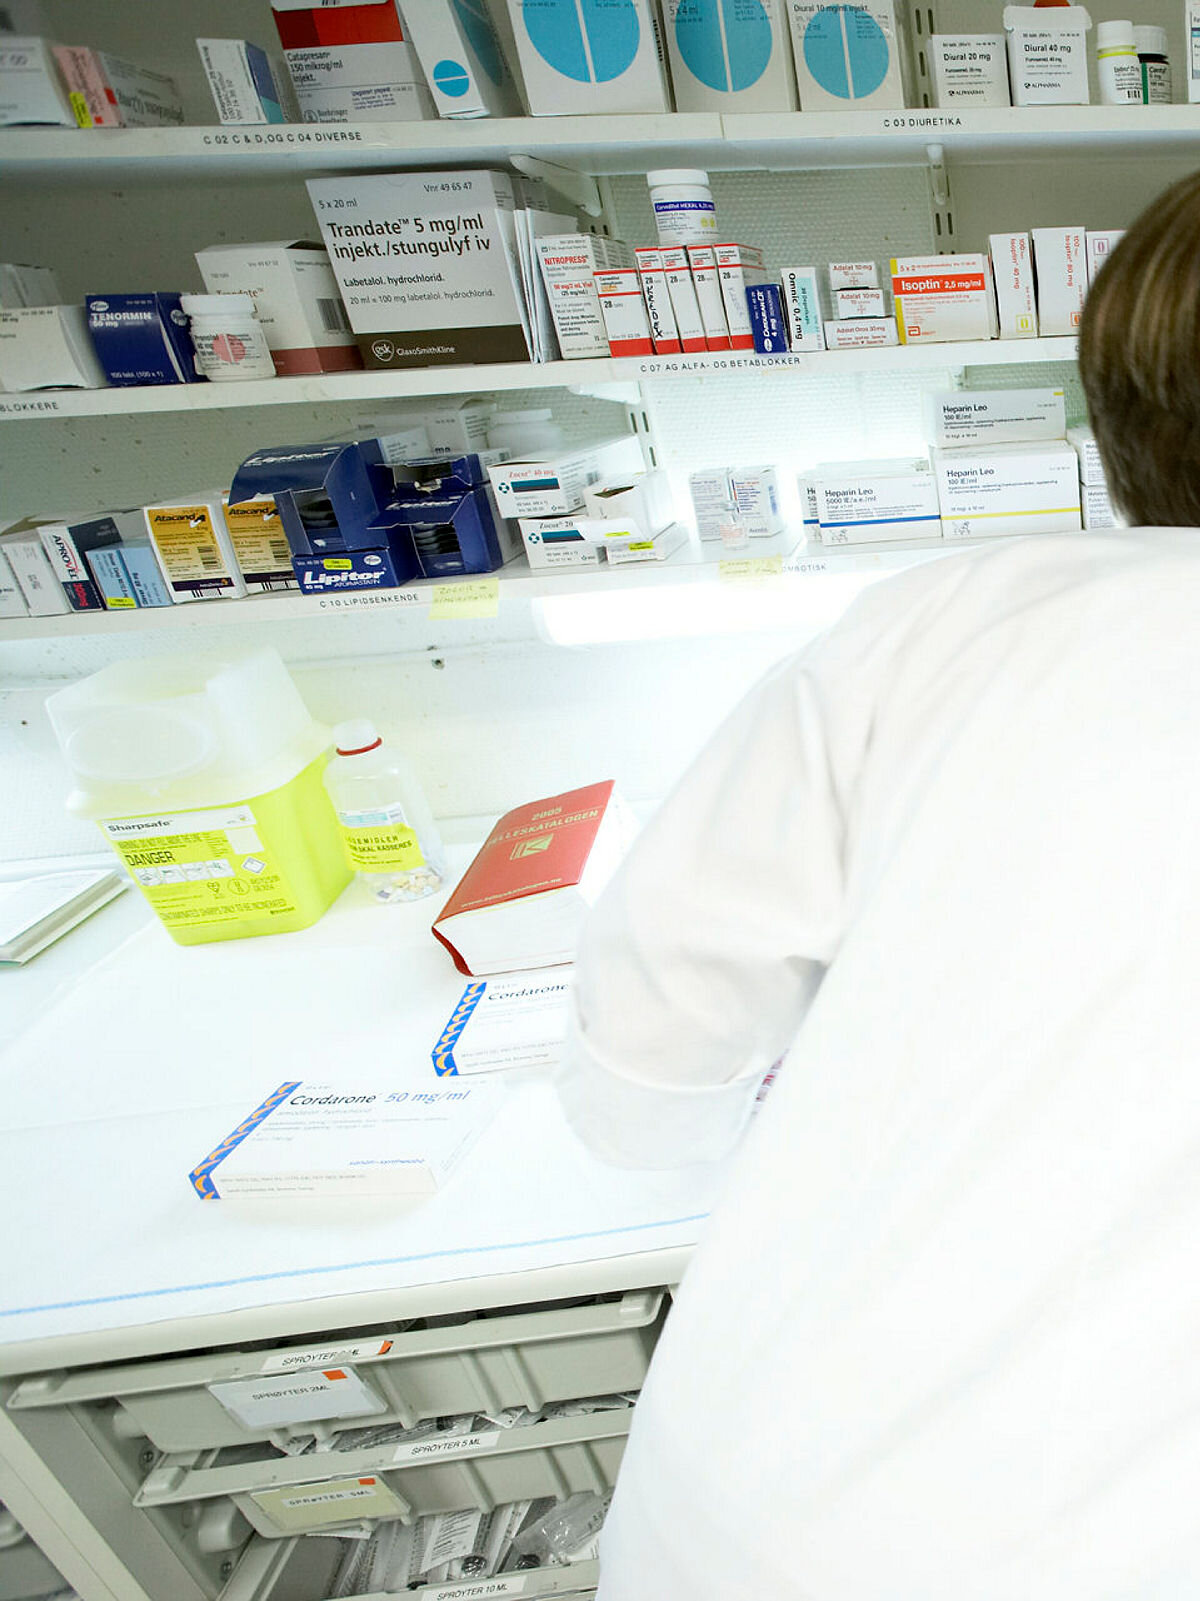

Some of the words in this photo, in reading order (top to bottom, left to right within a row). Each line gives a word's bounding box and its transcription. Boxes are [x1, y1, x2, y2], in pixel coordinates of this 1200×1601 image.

[943, 53, 967, 61] Diural
[968, 53, 978, 61] 20
[979, 54, 991, 62] mg
[883, 119, 890, 127] C
[893, 119, 905, 127] 03
[908, 117, 962, 126] DIURETIKA
[203, 135, 211, 145] C
[215, 135, 228, 145] 02
[233, 135, 241, 144] C
[244, 135, 251, 144] &
[287, 133, 295, 143] C
[299, 132, 312, 142] 04
[315, 131, 363, 142] DIVERSE
[440, 183, 450, 191] 49
[452, 182, 462, 191] 65
[463, 182, 473, 190] 47
[319, 200, 325, 209] 5
[334, 199, 345, 208] 20
[346, 198, 358, 208] ml
[414, 218, 425, 232] 5
[431, 213, 484, 235] mg/ml
[334, 235, 472, 262] injekt./stungulyf
[475, 235, 490, 250] iv
[901, 279, 940, 293] Isoptin
[957, 280, 981, 290] mg/ml
[789, 273, 798, 303] Omnic
[794, 324, 804, 340] mg
[90, 312, 153, 321] TENORMIN
[396, 344, 456, 356] GlaxoSmithKline
[640, 364, 647, 372] C
[650, 364, 661, 372] 07
[665, 363, 678, 371] AG
[713, 360, 727, 369] OG
[730, 357, 801, 368] BETABLOKKER
[943, 405, 973, 414] Heparin
[946, 469, 979, 478] Heparin
[979, 468, 995, 476] Leo
[825, 488, 857, 498] Heparin
[858, 487, 873, 495] Leo
[154, 513, 196, 522] Atacand
[228, 507, 269, 516] Atacand
[52, 534, 80, 580] APROVEL
[303, 569, 385, 587] Lipitor
[329, 600, 341, 608] 10
[343, 593, 420, 607] LIPIDSENKENDE
[531, 806, 563, 821] 2005
[107, 819, 169, 833] Sharpsafe
[124, 851, 176, 867] DANGER
[289, 1094, 377, 1106] Cordarone
[385, 1092, 409, 1103] 50
[411, 1089, 472, 1105] mg/ml
[462, 1440, 468, 1448] 5
[468, 1438, 481, 1446] ML
[486, 1585, 496, 1593] 10
[496, 1583, 508, 1591] ML
